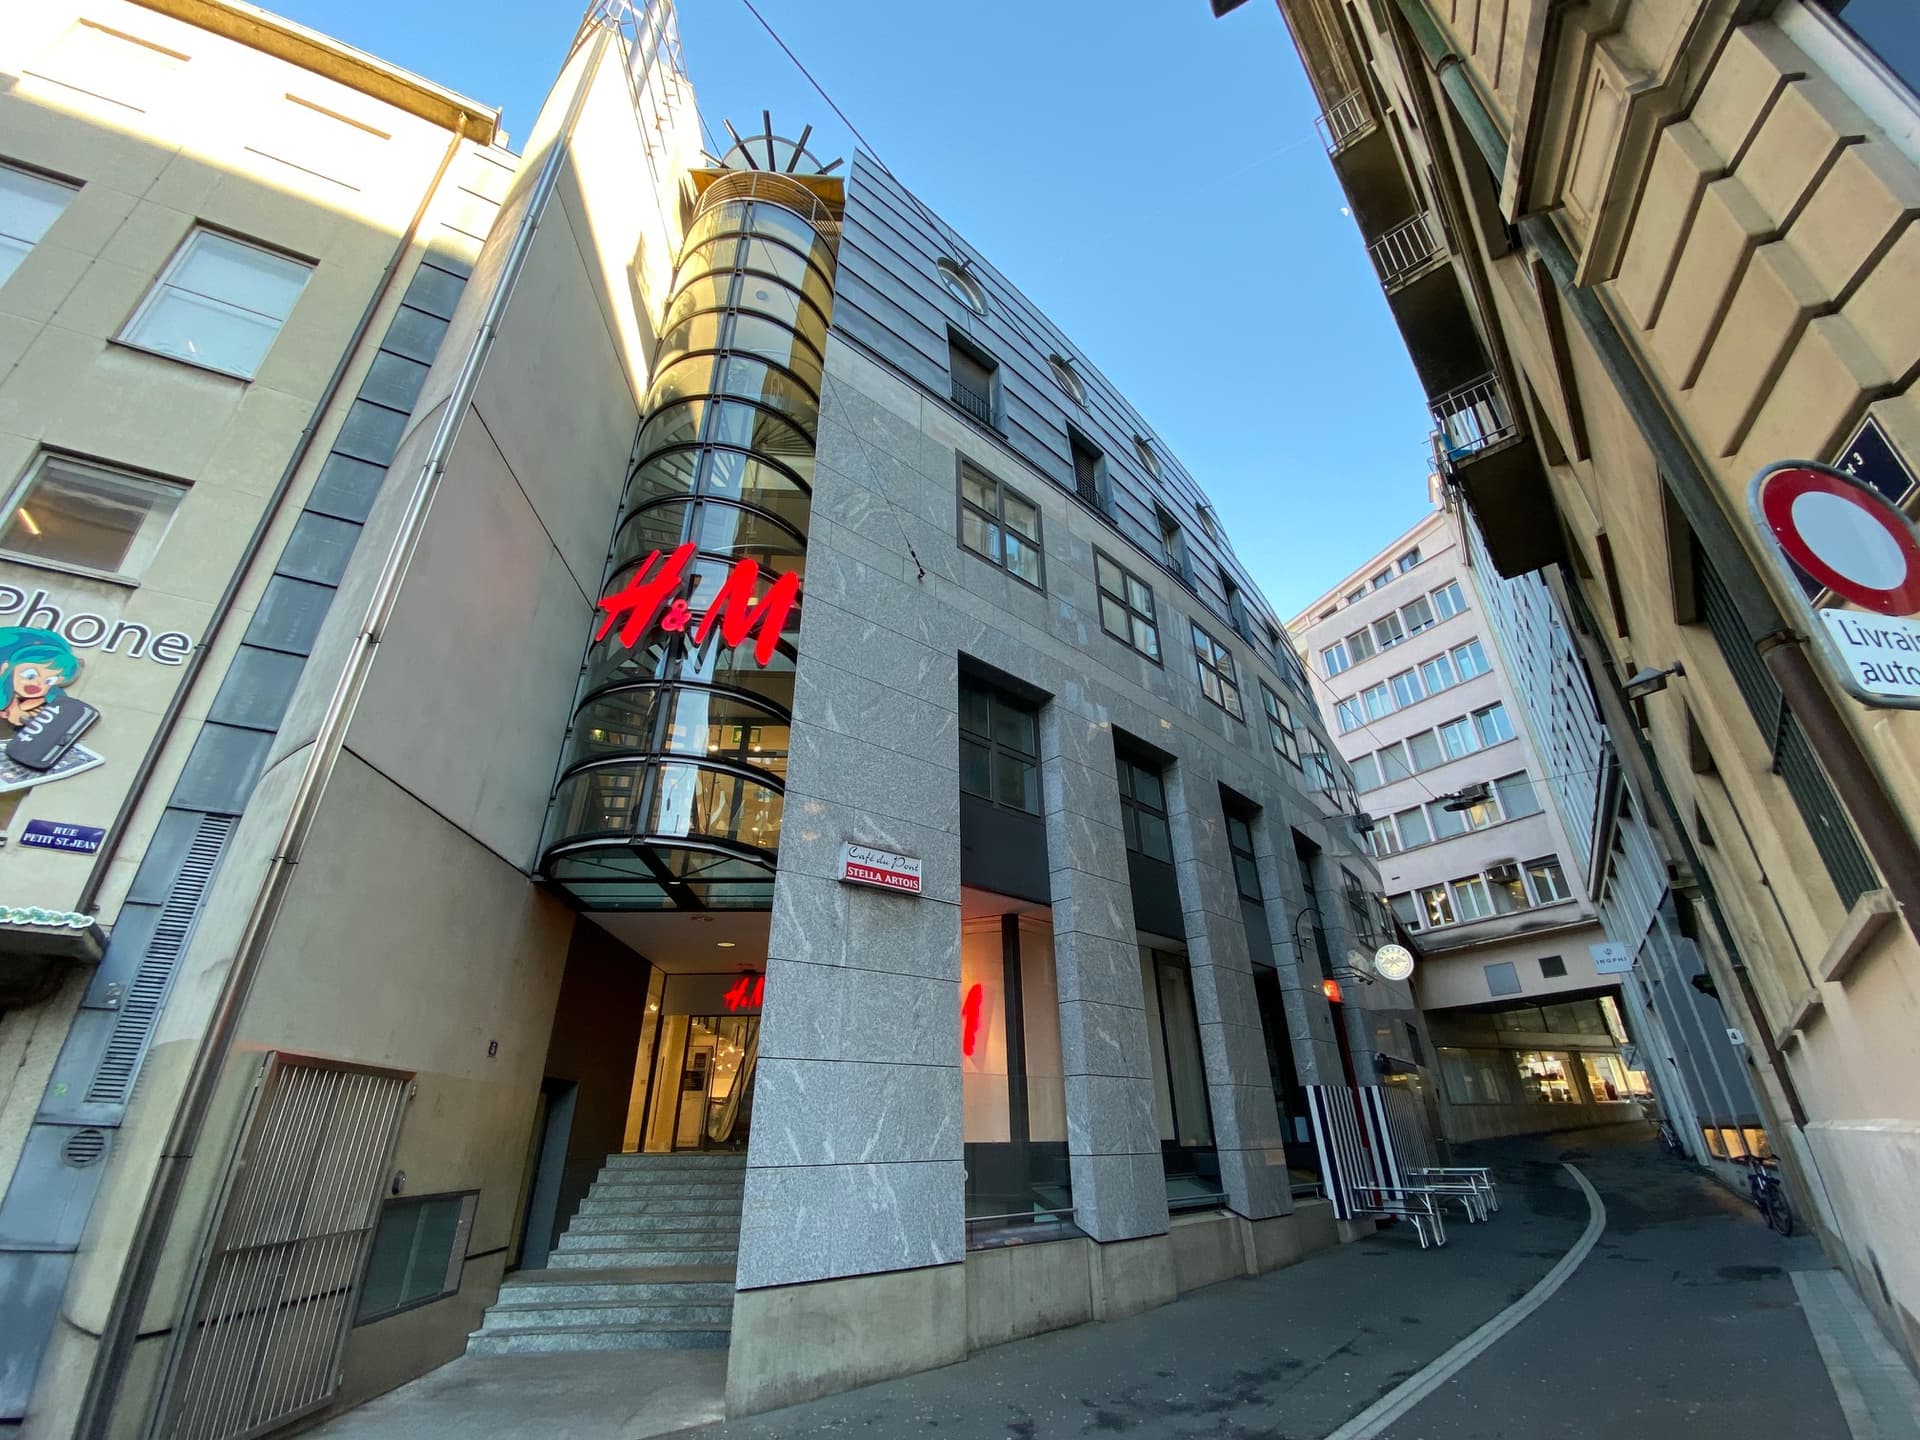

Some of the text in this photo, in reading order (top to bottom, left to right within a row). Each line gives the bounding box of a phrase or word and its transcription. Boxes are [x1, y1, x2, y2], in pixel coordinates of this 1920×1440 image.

[1853, 452, 1863, 466] 3
[595, 541, 799, 668] H&M
[23, 832, 55, 845] PETIT
[53, 826, 78, 837] RUE
[876, 854, 889, 865] du
[890, 856, 919, 871] Pont
[847, 866, 919, 889] STELLA ARTOIS
